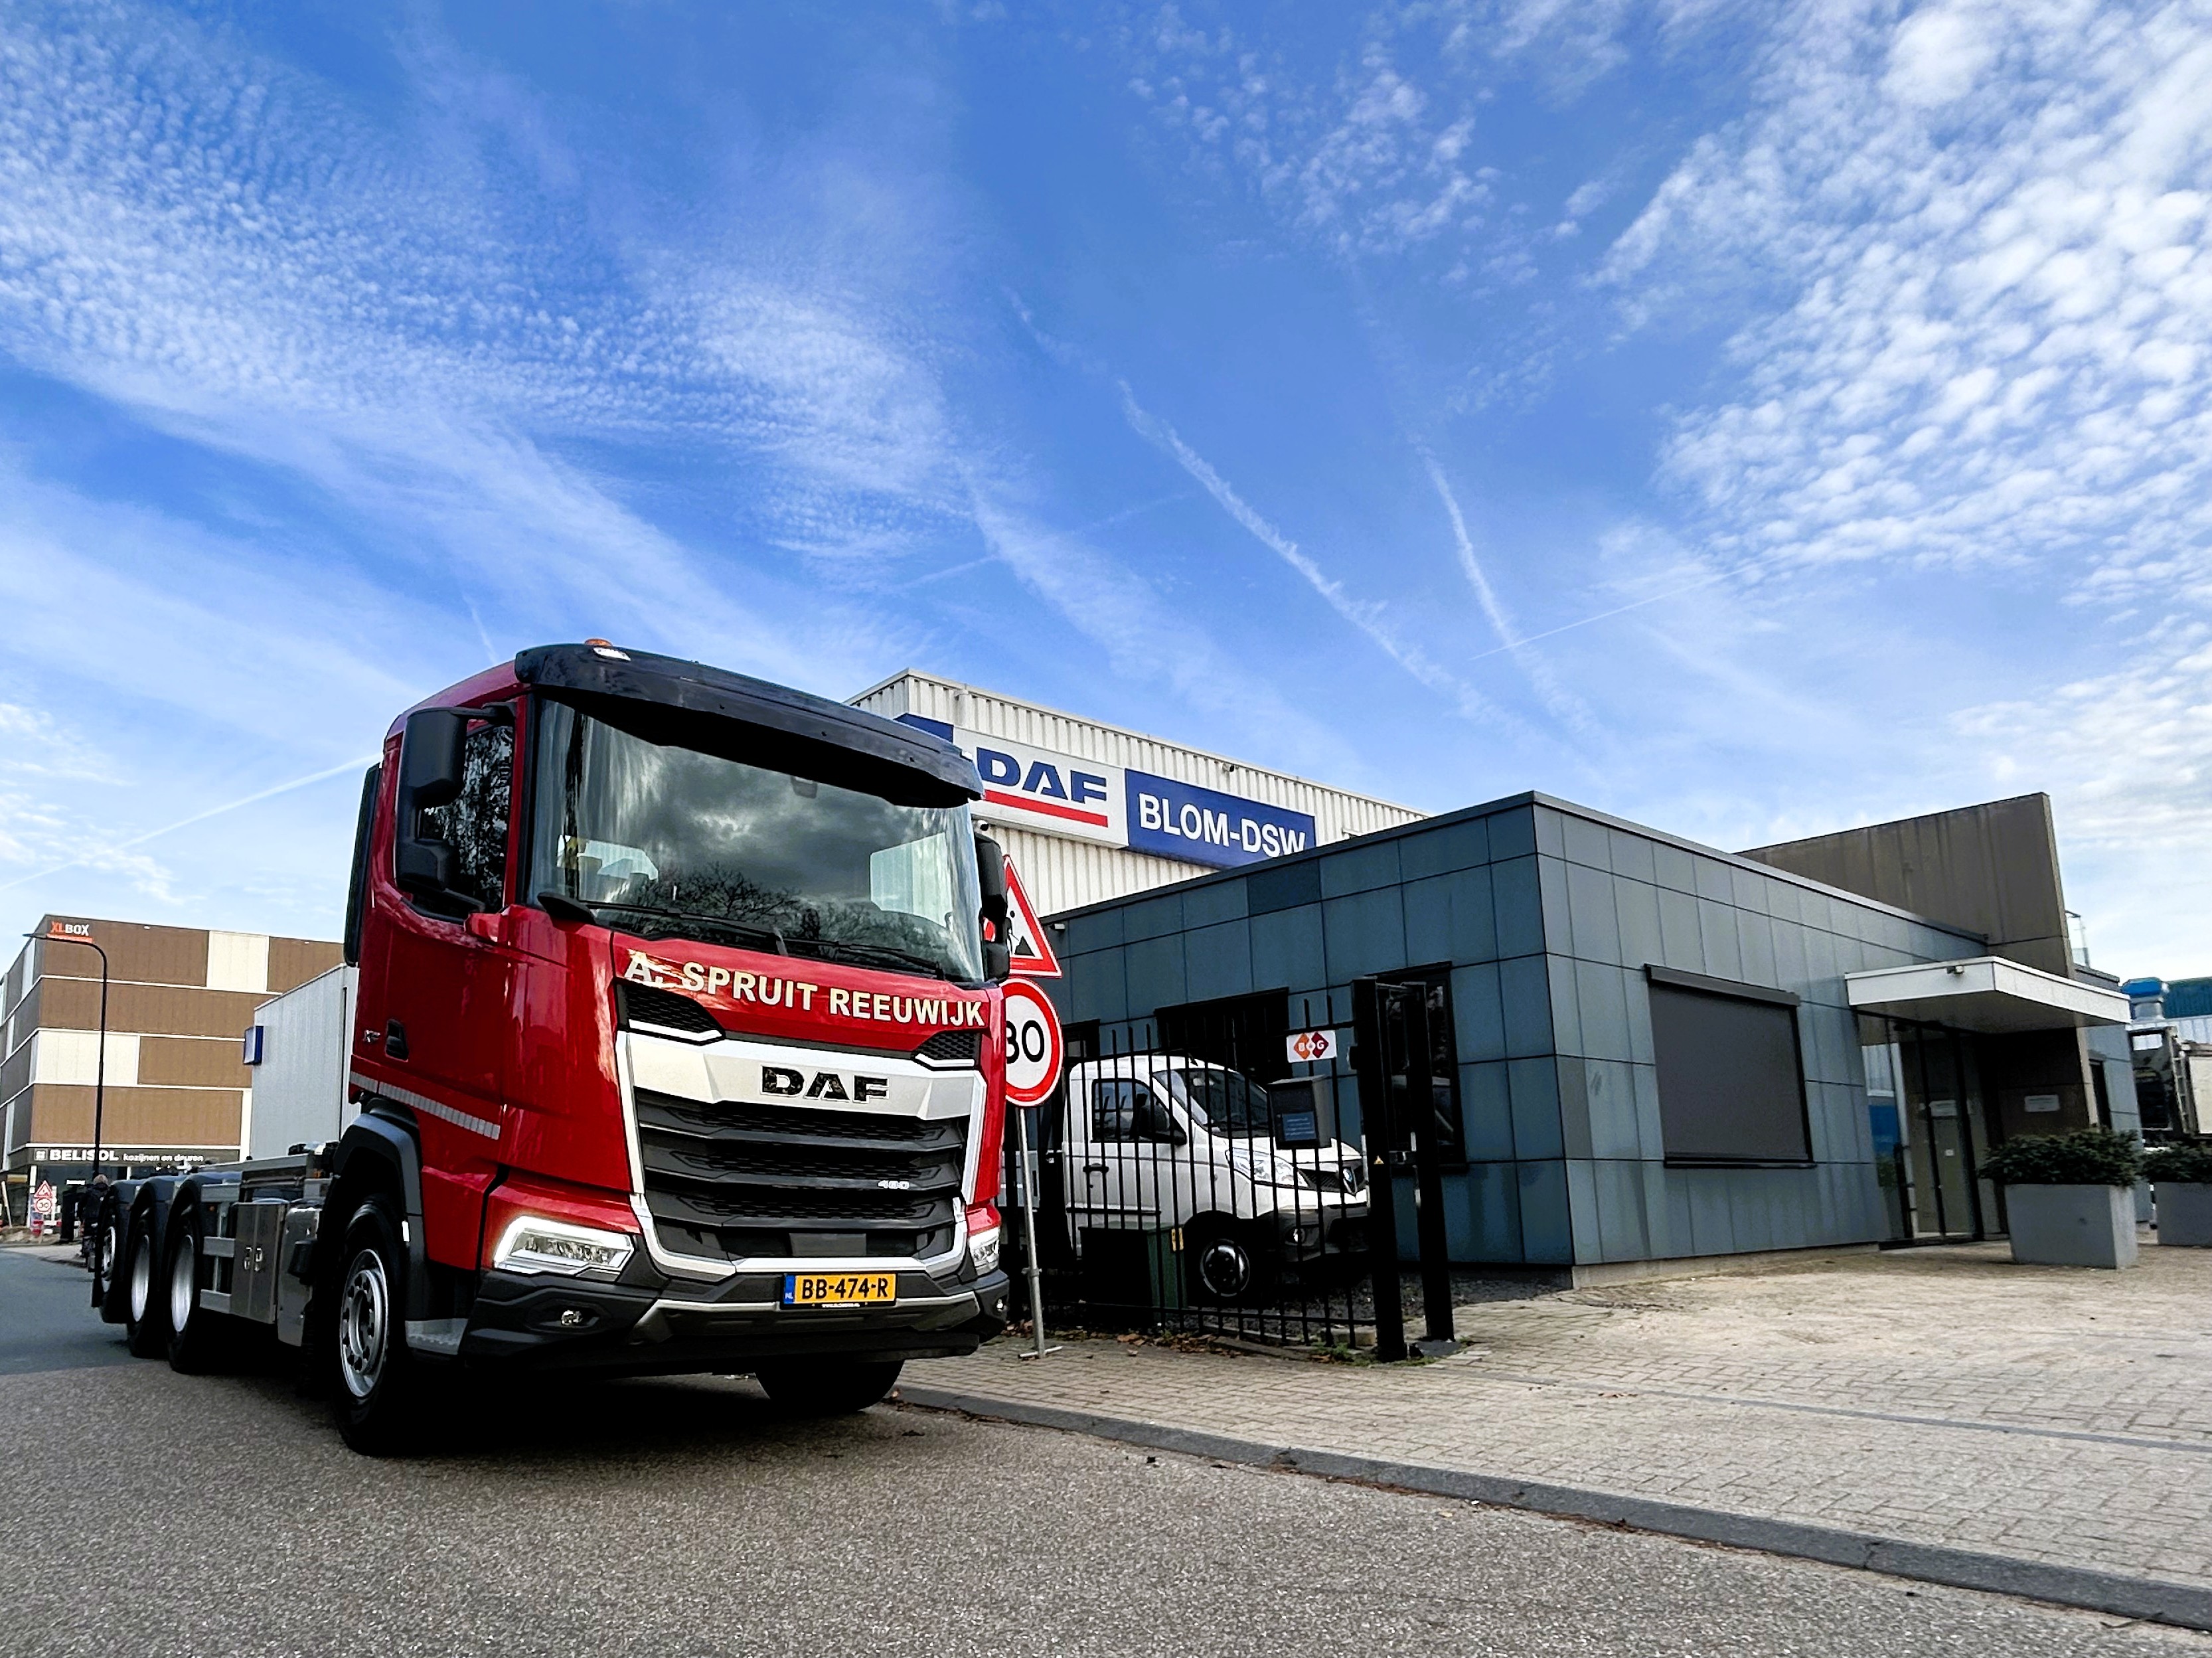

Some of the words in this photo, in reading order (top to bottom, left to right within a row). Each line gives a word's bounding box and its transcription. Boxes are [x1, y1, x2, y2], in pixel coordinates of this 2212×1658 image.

[977, 747, 1107, 804] DAF
[1139, 793, 1306, 858] BLOM-DSW
[682, 962, 819, 1011] SPRUIT
[830, 987, 985, 1027] REEUWIJK
[1006, 1020, 1045, 1064] 30
[760, 1065, 890, 1104] DAF
[49, 1149, 119, 1161] BELISOL
[123, 1153, 160, 1163] kozijnen
[802, 1278, 889, 1300] BB-474-R
